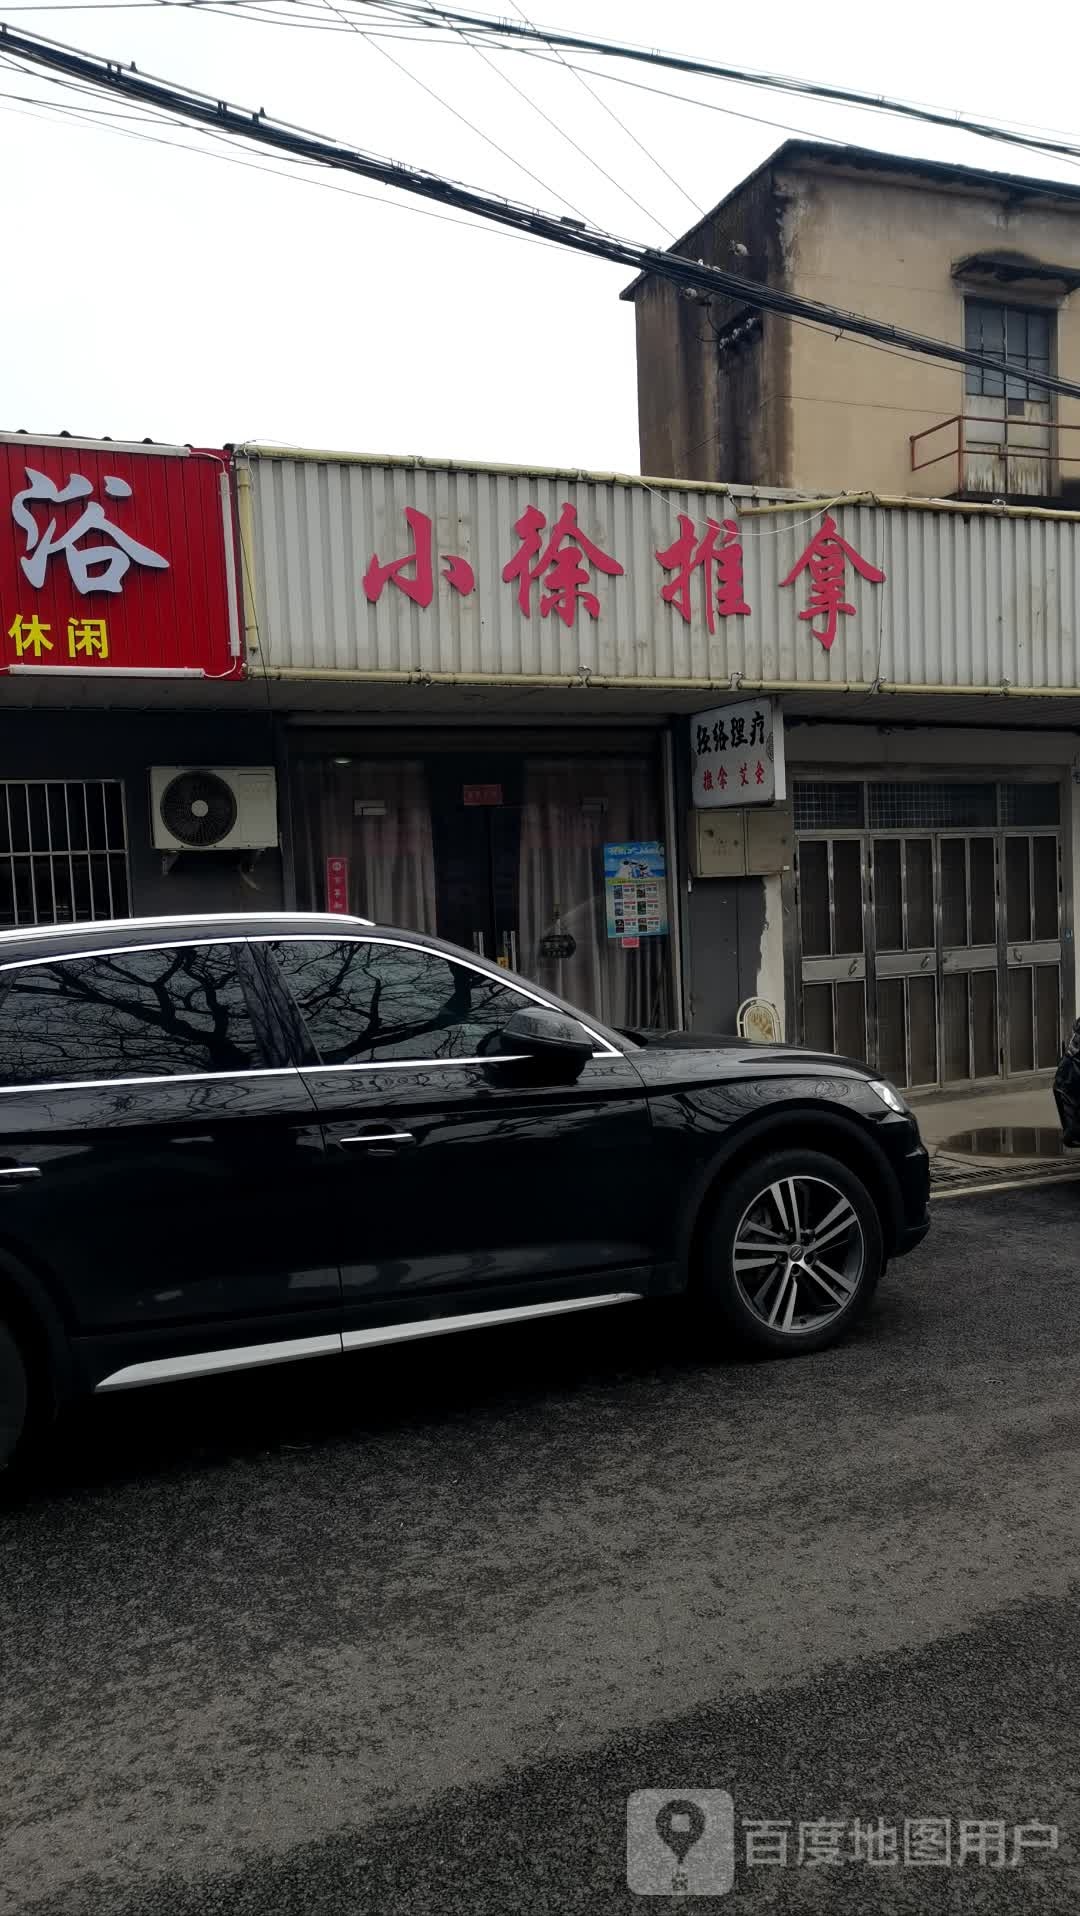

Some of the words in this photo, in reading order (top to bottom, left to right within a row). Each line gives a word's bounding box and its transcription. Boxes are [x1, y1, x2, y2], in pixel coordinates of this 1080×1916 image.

[12, 467, 170, 594] 浴
[362, 502, 887, 651] 小徐推拿
[8, 614, 109, 659] 休闲
[697, 711, 765, 755] 经络理疗
[703, 765, 728, 791] 推拿
[739, 760, 765, 786] 艾灸
